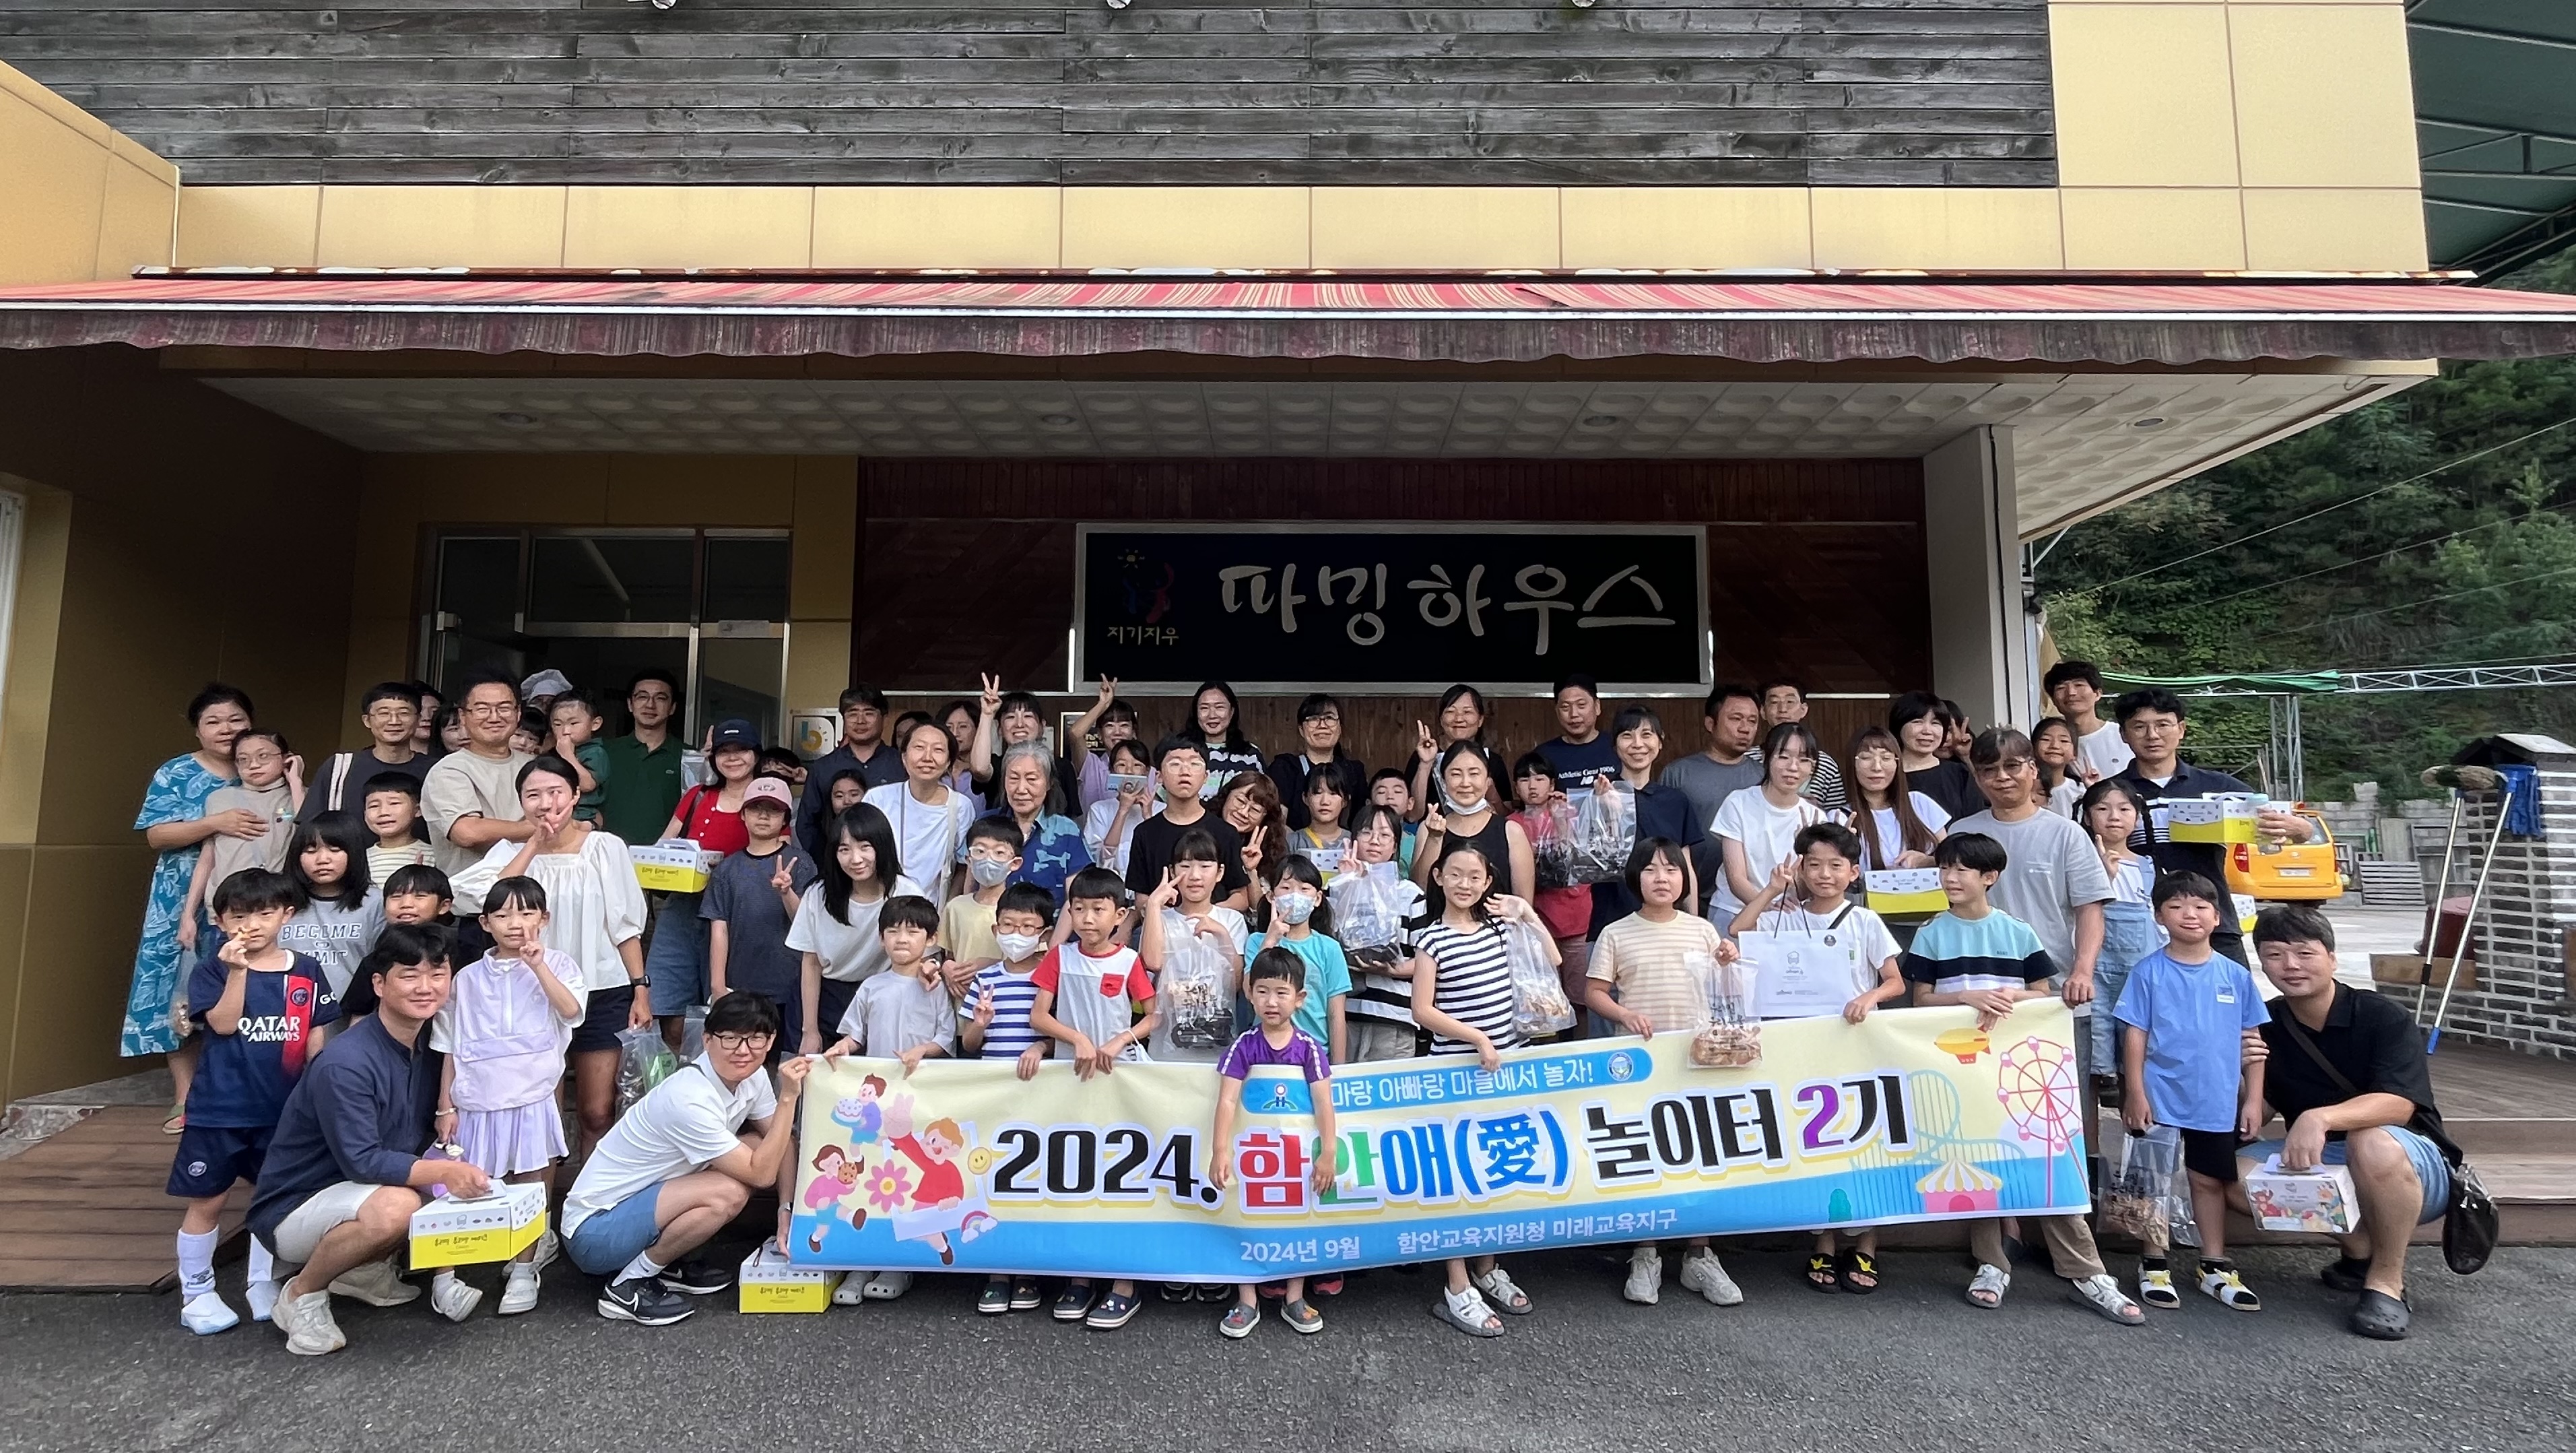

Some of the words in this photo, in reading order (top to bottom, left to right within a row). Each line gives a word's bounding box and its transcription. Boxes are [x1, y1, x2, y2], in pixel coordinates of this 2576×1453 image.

[1107, 626, 1179, 645] 지기지우
[238, 1016, 300, 1035] QATAR
[247, 1031, 300, 1042] AIRWAYS
[1331, 1080, 1373, 1107] 마랑
[1379, 1073, 1445, 1103] 아빠랑
[1451, 1064, 1538, 1095] 마을에서
[1544, 1059, 1593, 1087] 놀자!
[994, 1129, 1218, 1203] 2024.
[1586, 1089, 1783, 1180] 놀이터
[1797, 1075, 1908, 1149] 2기
[1397, 1220, 1545, 1254] 함안교육지원청
[1553, 1208, 1678, 1239] 미래교육지구
[1240, 1239, 1317, 1262] 2024년
[1324, 1236, 1360, 1260] 9월
